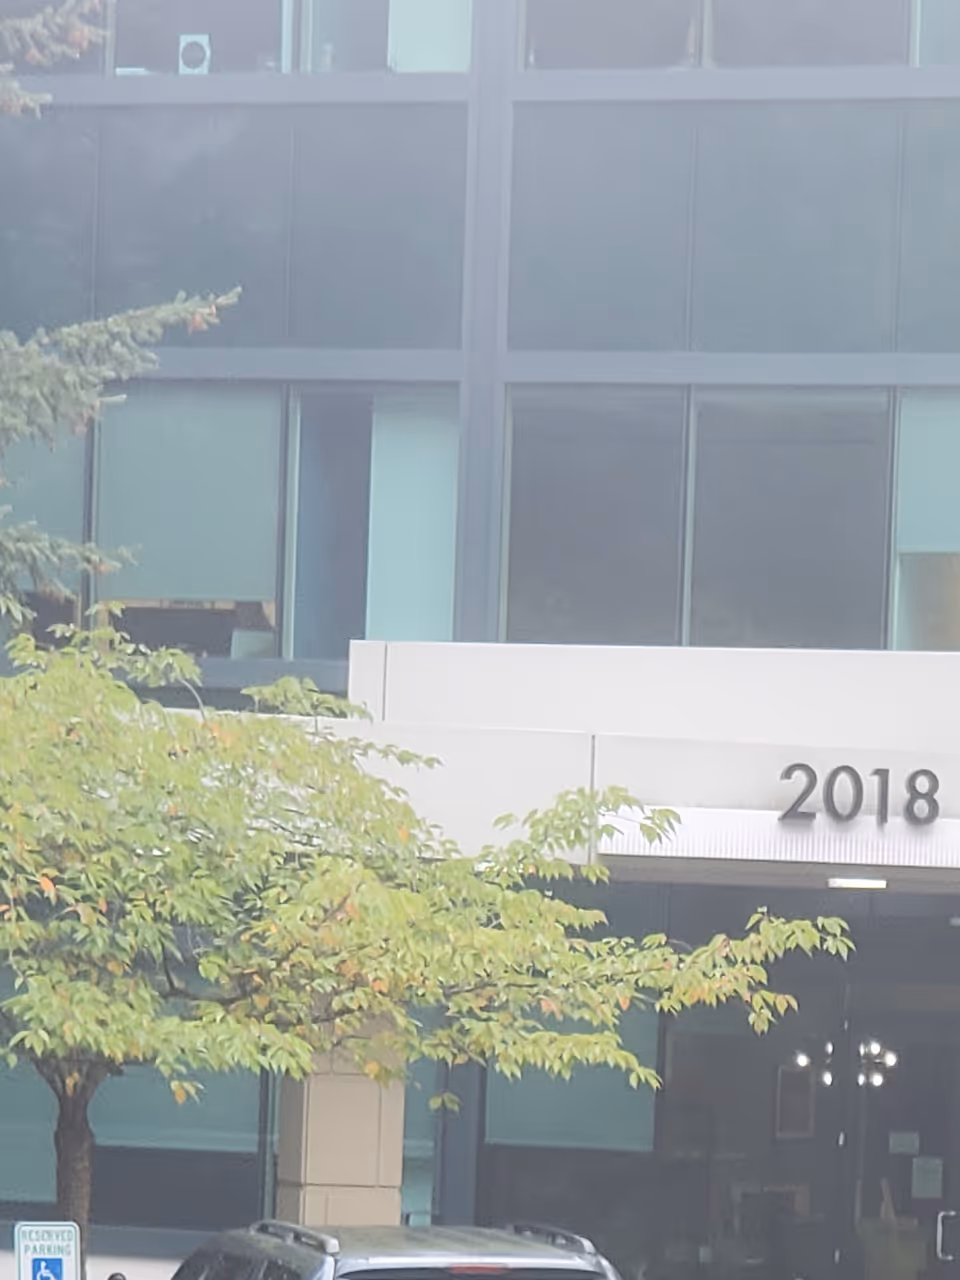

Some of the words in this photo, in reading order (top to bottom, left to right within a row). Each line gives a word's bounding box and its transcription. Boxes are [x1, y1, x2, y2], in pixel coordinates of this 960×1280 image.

[778, 762, 940, 825] 2018
[21, 1229, 73, 1242] RESERVED
[24, 1243, 72, 1256] PARKING
